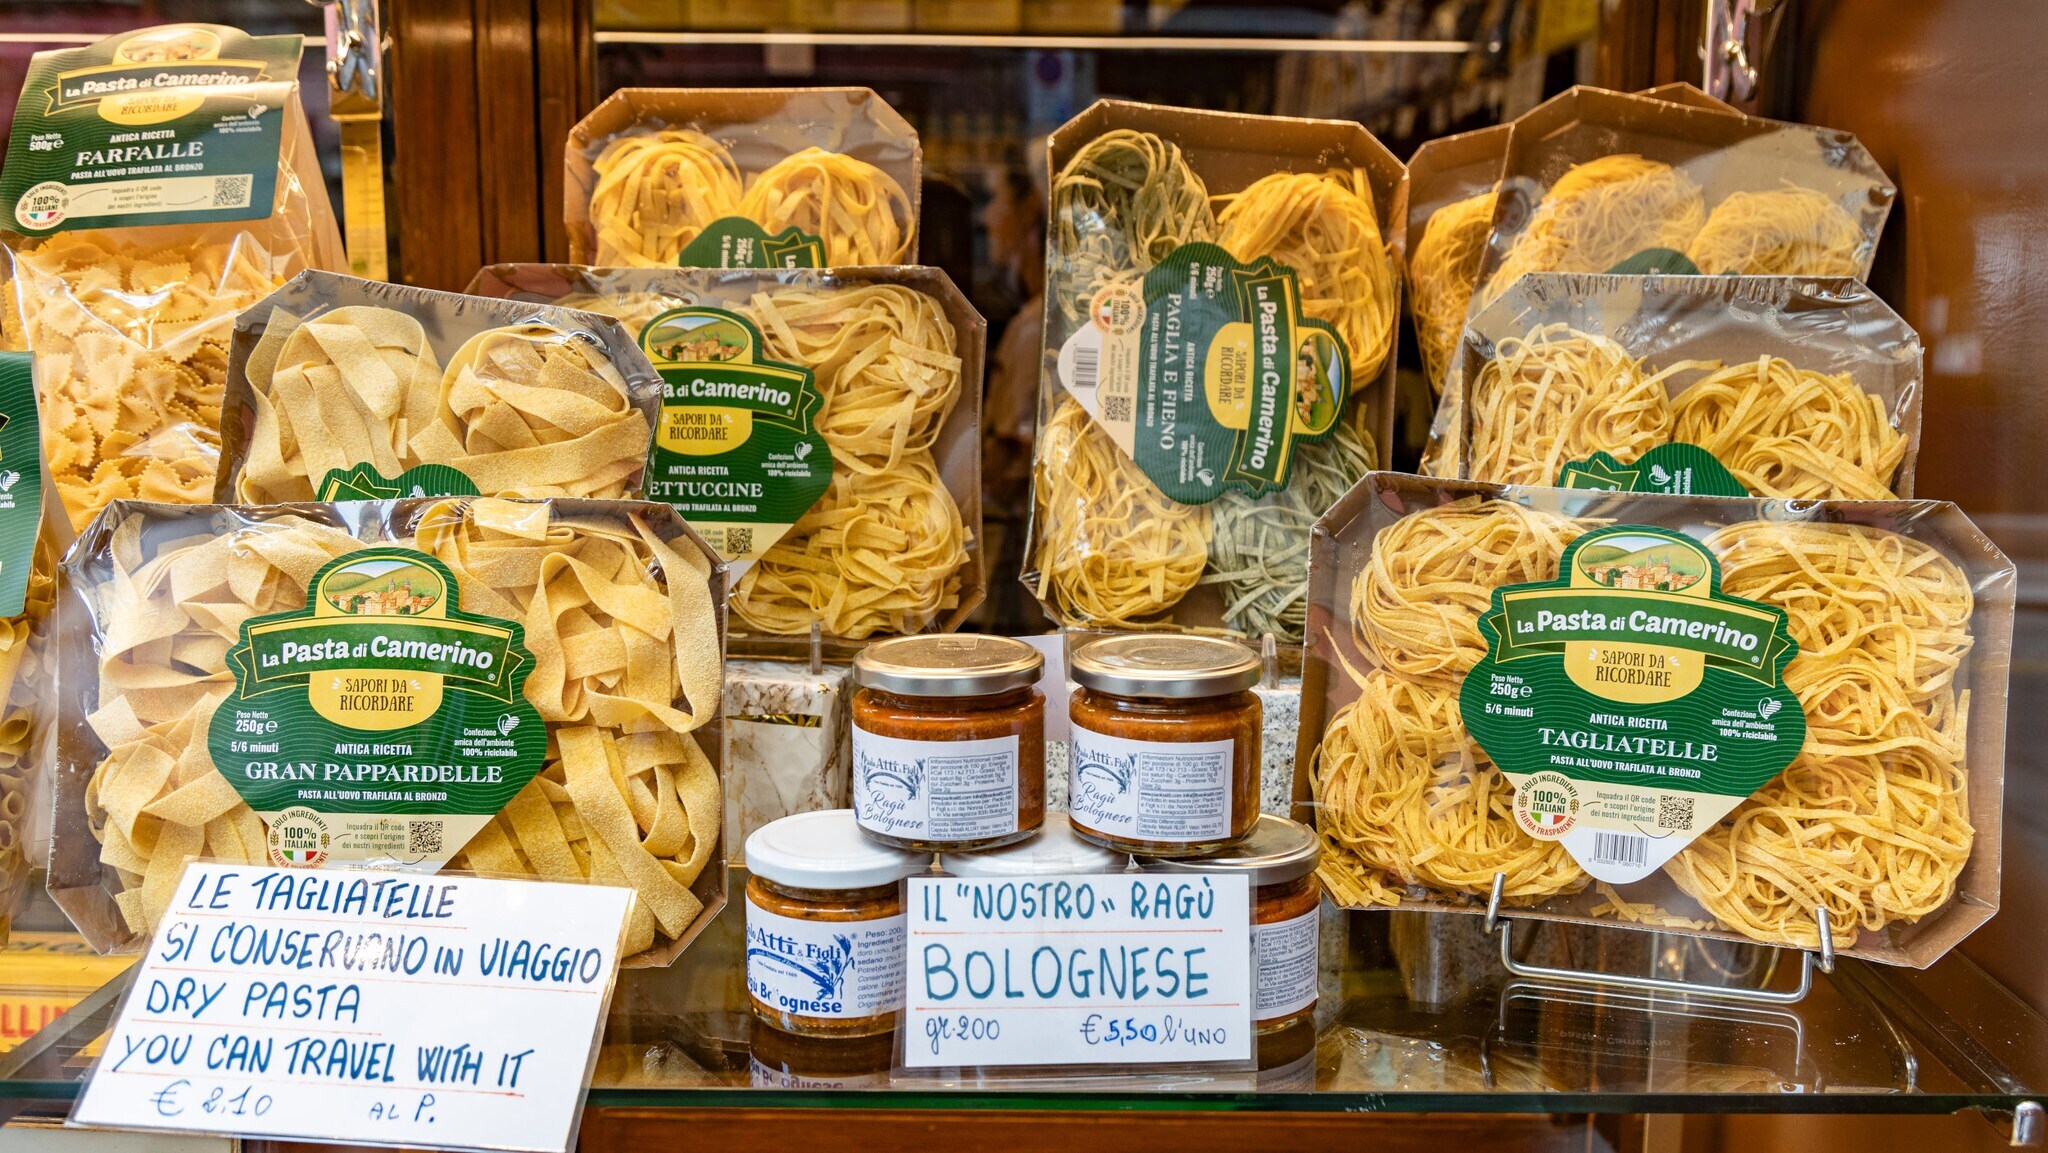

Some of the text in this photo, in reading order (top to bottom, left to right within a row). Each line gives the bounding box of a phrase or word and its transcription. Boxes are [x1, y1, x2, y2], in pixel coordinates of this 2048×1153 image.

[65, 71, 250, 98] La Pasta di Camerino
[121, 102, 179, 116] RICORDARE
[109, 129, 176, 144] ANTICA RICETTA
[75, 141, 205, 166] FARFALLE
[71, 162, 204, 180] PASTA ALL'UOVO TRAFILATA BRONZO
[31, 203, 59, 212] ITALIANI
[33, 195, 60, 206] 100%
[1146, 312, 1160, 427] PASTA TRAFILATA BRONZO
[1160, 293, 1182, 450] PAGLIA E FIENO
[1184, 341, 1196, 402] ANTICA RICETTA
[1219, 347, 1234, 405] RICORDARE
[1234, 352, 1247, 400] SAPORI DA
[1250, 286, 1281, 470] La Pasta di Camerino
[677, 384, 689, 398] di
[691, 378, 792, 407] Camerino
[673, 413, 722, 425] SAPORI DA
[669, 426, 728, 440] RICORDARE
[668, 465, 729, 476] ANTICA RICETTA
[650, 481, 764, 498] ETTUCCINE
[691, 504, 722, 512] TRAFILATA
[732, 504, 757, 513] BRONZO
[1517, 610, 1759, 651] La Pasta di Camerino
[262, 636, 494, 670] La Pasta di Camerino
[1601, 650, 1666, 670] SAPORI DA
[345, 678, 408, 694] SAPORI DA
[1490, 674, 1524, 684] Peso Netto
[1594, 666, 1672, 688] RICORDARE
[1490, 683, 1518, 699] 250g
[340, 694, 415, 712] RICORDARE
[1485, 703, 1534, 718] 5/6 minuti
[236, 710, 269, 720] Peso Netto
[1590, 713, 1668, 731] ANTICA RICETTA
[1722, 708, 1757, 719] Confezione
[236, 720, 264, 736] 250g
[464, 728, 497, 738] Confezione
[1712, 718, 1775, 731] amica dell'ambiente
[454, 738, 515, 747] amica dell'ambiente
[1720, 728, 1778, 742] 100% riciclabile
[230, 741, 280, 753] 5/6 minuti
[334, 744, 412, 756] ANTICA RICETTA
[462, 748, 518, 758] 100% riciclabile
[1538, 728, 1718, 762] TAGLIATELLE
[876, 758, 920, 776] Atti Figli
[1088, 749, 1132, 771] Atti Figli
[1550, 755, 1701, 779] PASTA ALL'UOVO TRAFILATA AL BRONZO
[245, 761, 504, 783] GRAN PAPPARDELLE
[1081, 780, 1116, 808] Ragù
[1522, 774, 1578, 798] SOLO INGREDIENTI
[298, 790, 448, 802] PASTA ALL'UOVO TRAFILATA AL BRONZO
[870, 790, 907, 816] Ragù
[1532, 789, 1566, 805] 100%
[1596, 790, 1656, 804] Inquadra QR code
[1073, 794, 1133, 824] Bolognese
[1532, 802, 1566, 814] ITALIANI
[1602, 810, 1655, 823] nostri ingredienti
[1608, 802, 1656, 814] scopri l'origine
[272, 811, 328, 832] SOLO INGREDIENTI
[346, 822, 405, 831] Inquadra code
[862, 804, 924, 832] Bolognese
[1518, 810, 1576, 837] FILIERA TRASPARENTE
[284, 826, 317, 840] 100%
[360, 833, 405, 842] scopri l'origine
[284, 840, 316, 849] ITALIANI
[372, 842, 405, 850] ingredienti
[188, 872, 458, 918] LE TAGLIATELLE
[924, 884, 948, 923] IL
[1130, 876, 1214, 920] RAGÙ
[161, 922, 198, 962] SI
[433, 946, 464, 977] IN
[480, 937, 602, 984] VIAGGIO
[756, 927, 798, 957] Atti
[805, 943, 842, 964] Figli
[922, 943, 1209, 1001] BOLOGNESE
[146, 976, 360, 1024] DRY PASTA
[760, 980, 842, 1014] Bognese
[111, 1034, 536, 1088] YOU CAN TRAVEL WITH IT
[148, 1078, 192, 1117] €
[414, 1092, 436, 1124] P.
